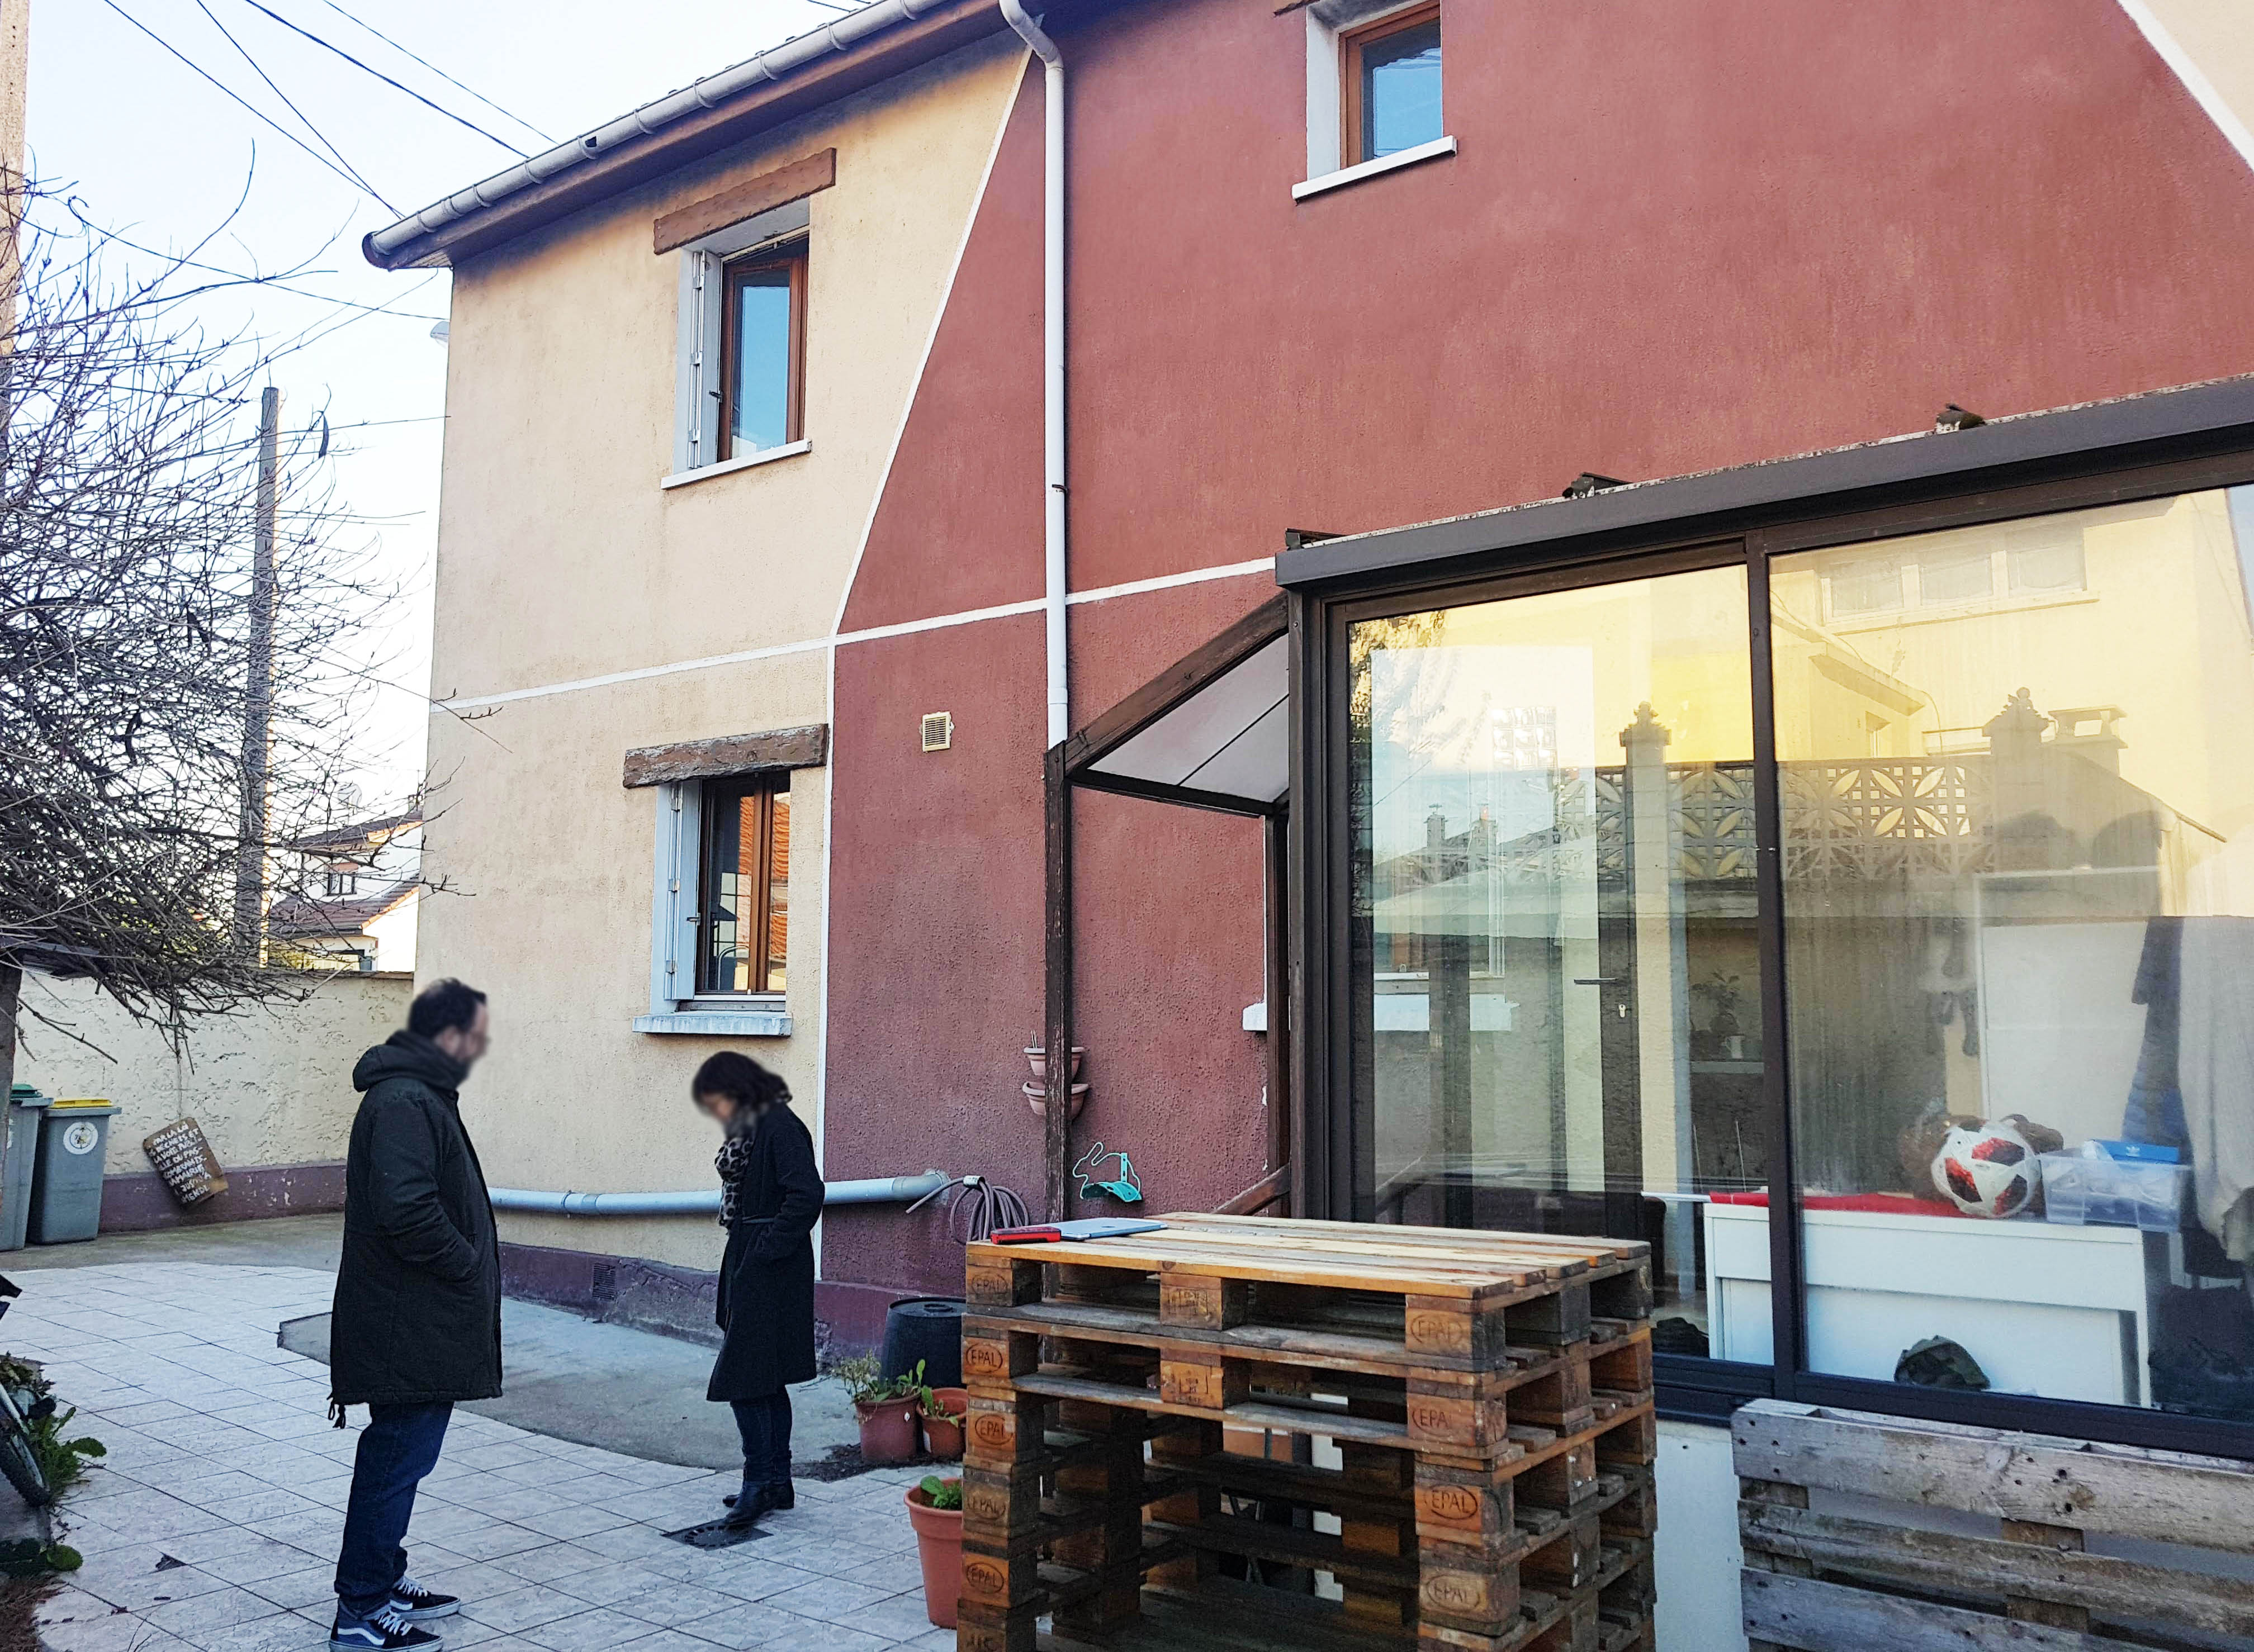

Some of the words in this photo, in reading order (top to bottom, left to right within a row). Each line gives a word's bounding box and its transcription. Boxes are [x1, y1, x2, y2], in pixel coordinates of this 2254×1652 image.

[970, 1349, 997, 1368] EPAL
[1420, 1408, 1450, 1430] EPA
[1432, 1490, 1468, 1513] EPAL
[972, 1568, 998, 1588] EPAL
